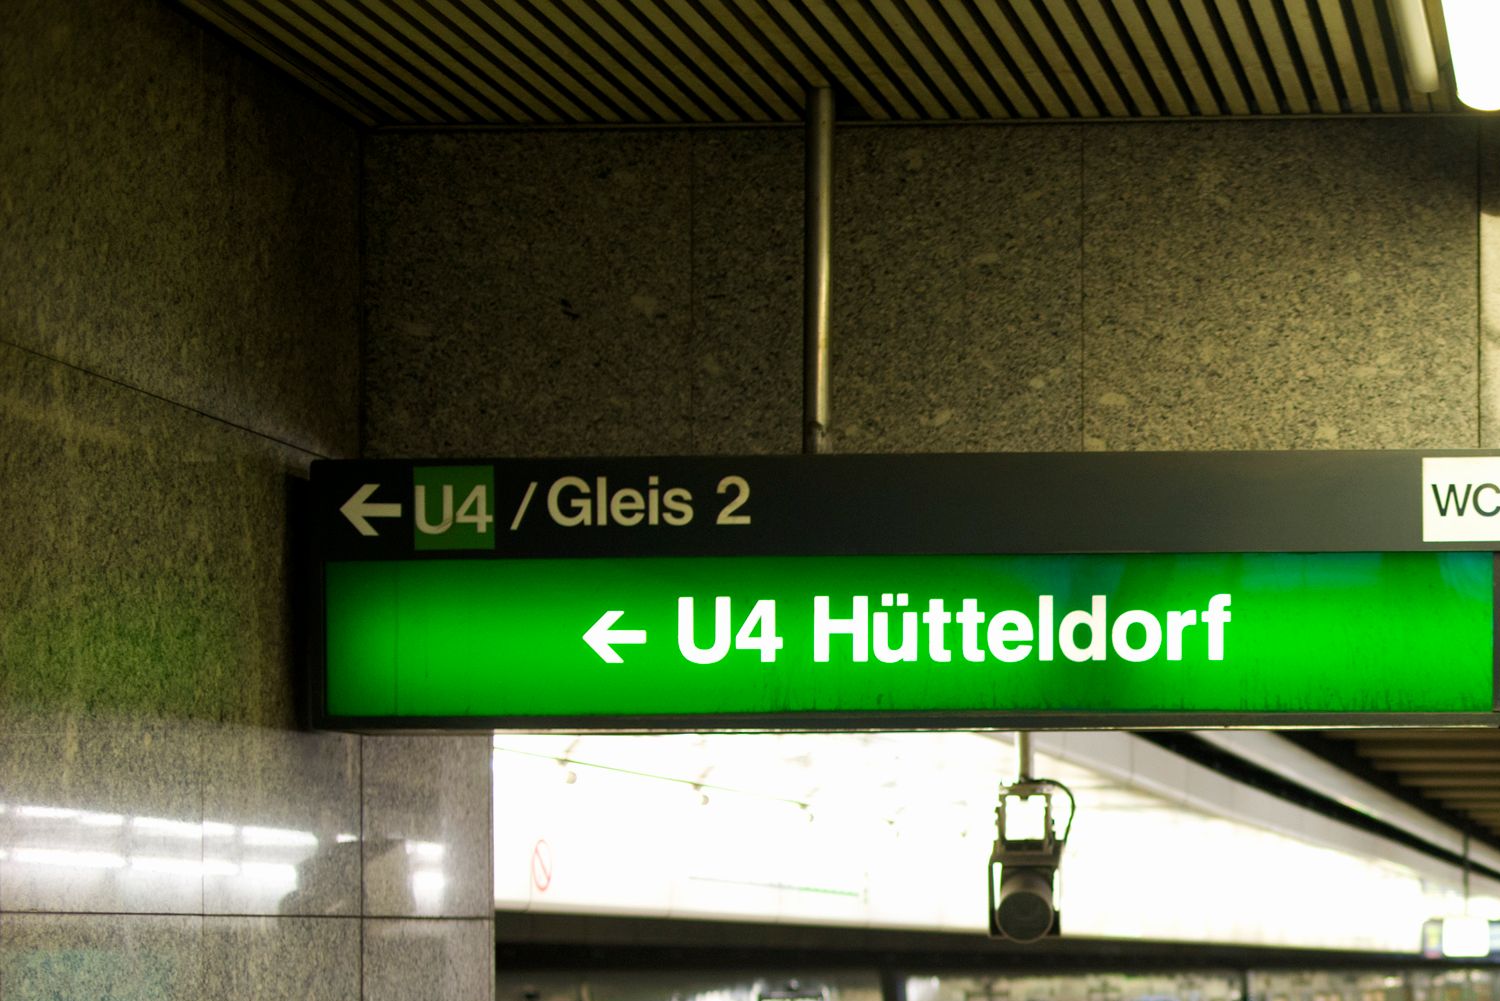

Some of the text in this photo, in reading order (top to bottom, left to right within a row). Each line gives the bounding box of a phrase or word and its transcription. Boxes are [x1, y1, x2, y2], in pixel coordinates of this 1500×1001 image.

[414, 483, 494, 534] U4
[716, 474, 752, 525] 2
[677, 592, 1232, 665] U4 Hütteldorf
